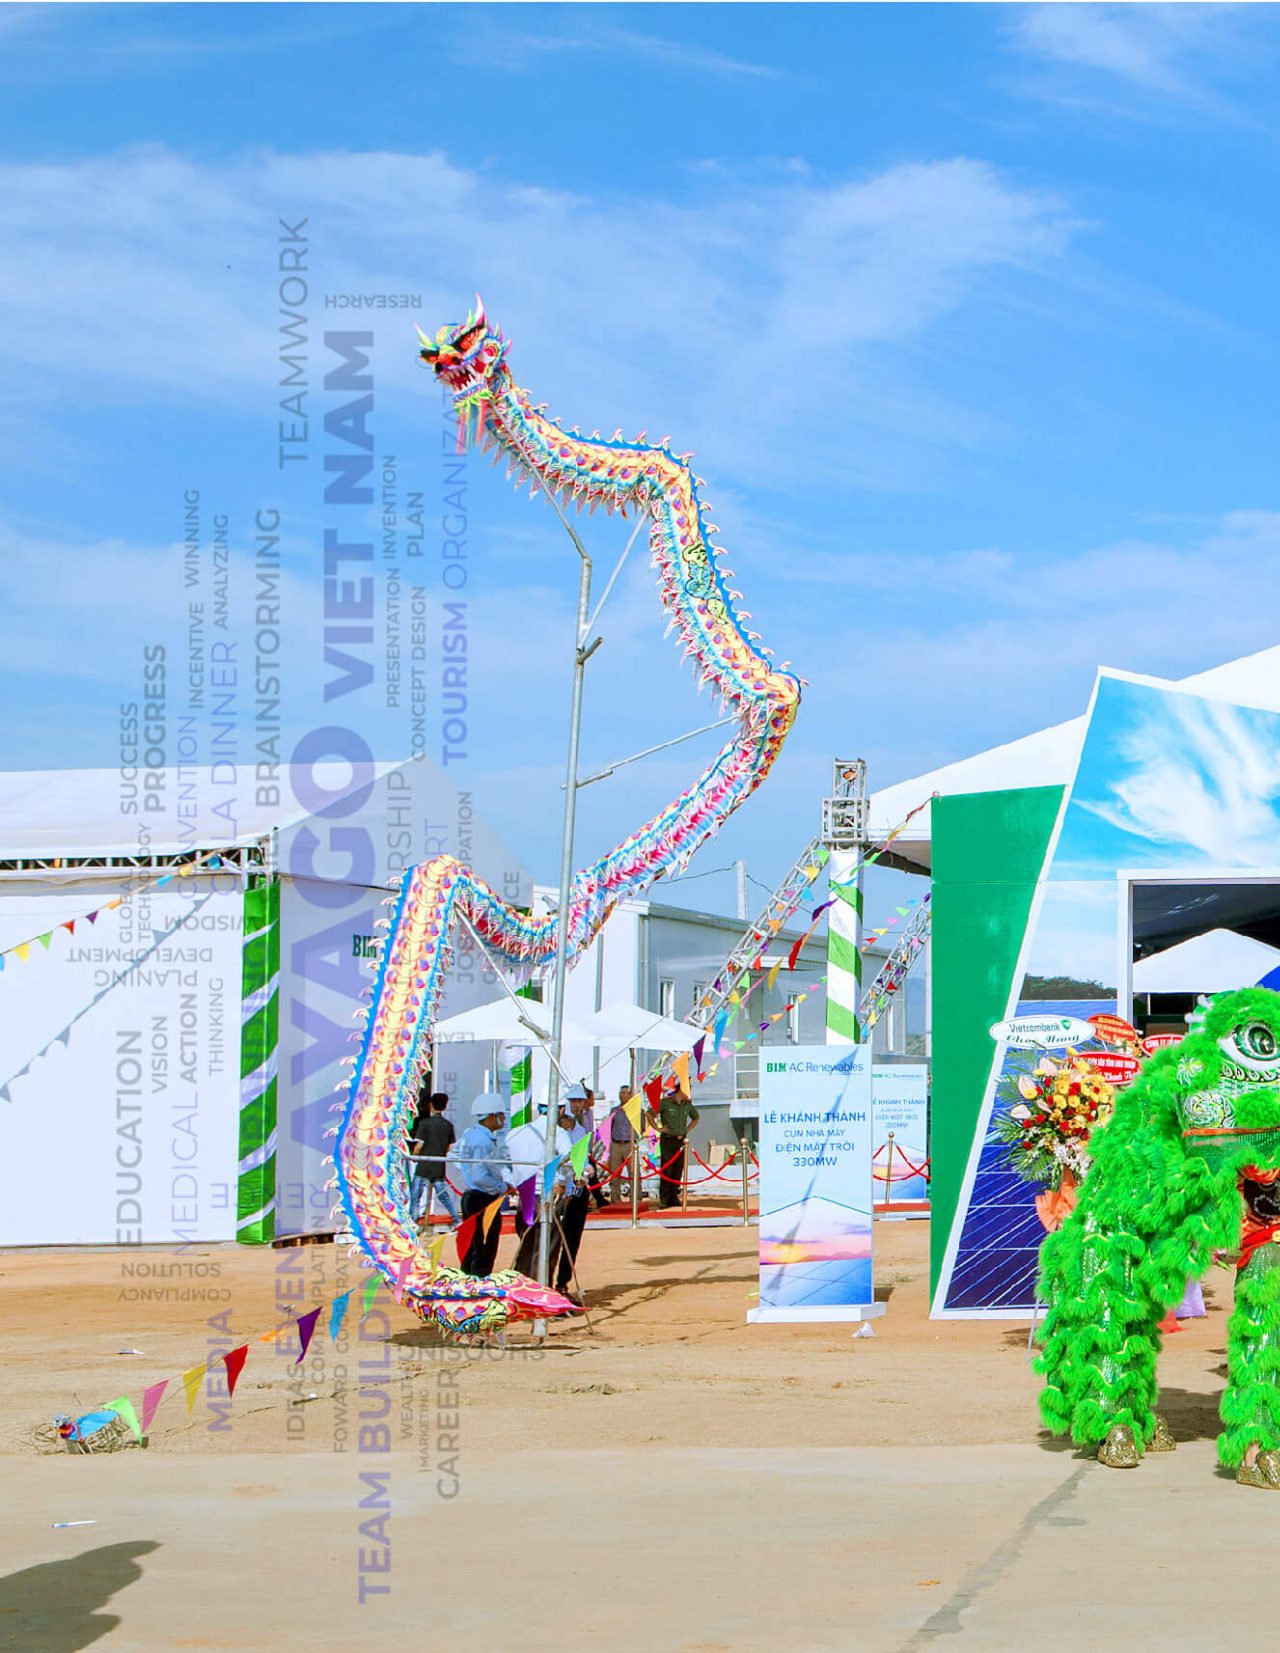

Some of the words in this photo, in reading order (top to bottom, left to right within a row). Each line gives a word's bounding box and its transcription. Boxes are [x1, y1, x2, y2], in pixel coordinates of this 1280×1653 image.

[1009, 1022, 1060, 1033] Vietcombank
[766, 1062, 787, 1073] BIM
[789, 1061, 804, 1073] AC
[806, 1061, 864, 1072] Renewables
[793, 1157, 838, 1167] 330MW
